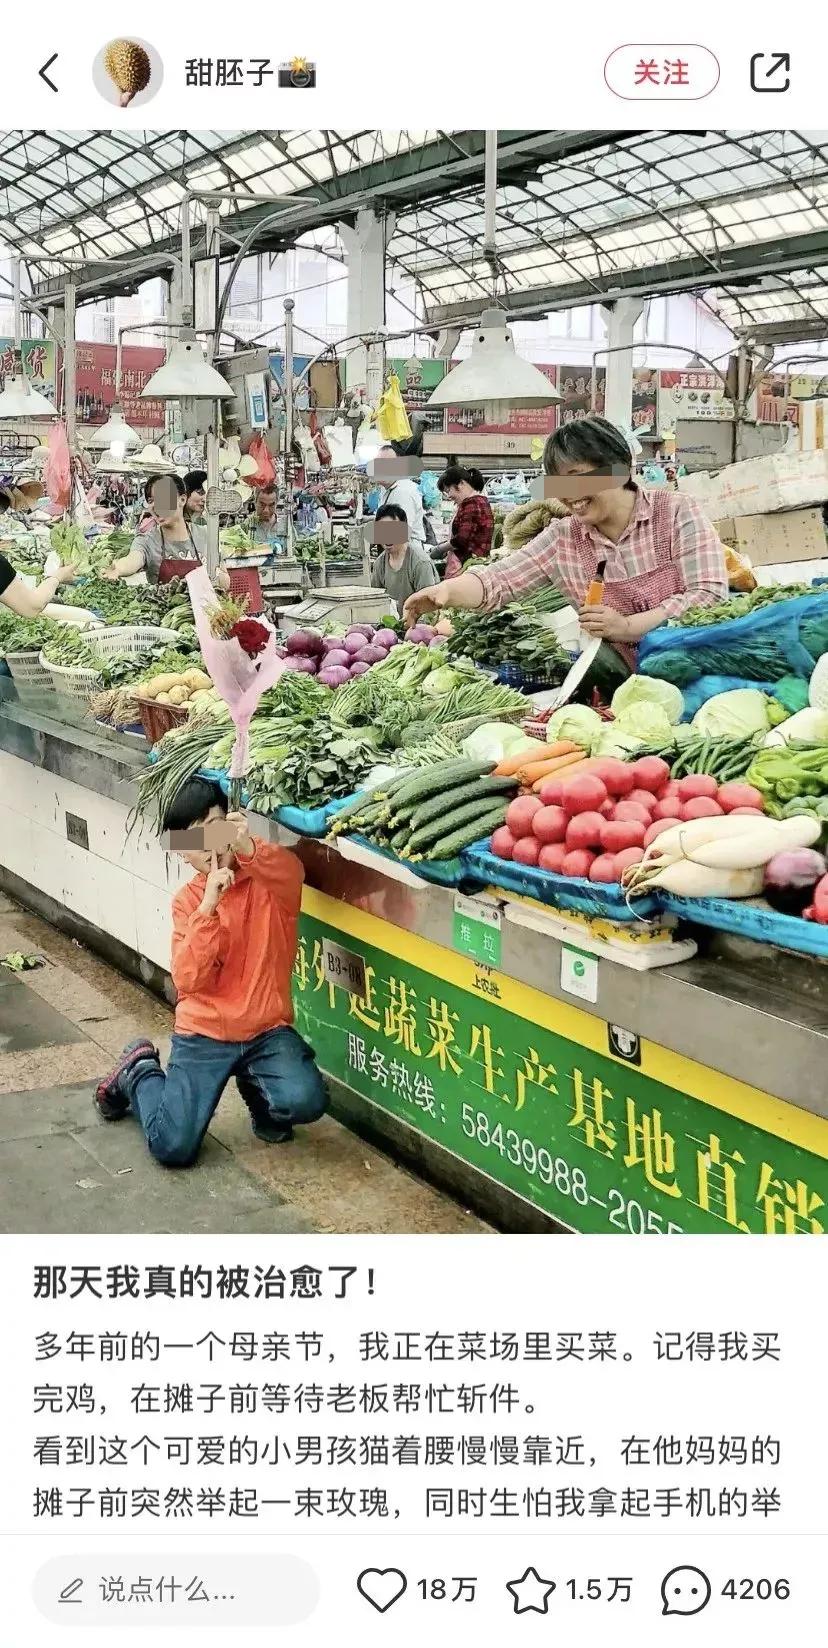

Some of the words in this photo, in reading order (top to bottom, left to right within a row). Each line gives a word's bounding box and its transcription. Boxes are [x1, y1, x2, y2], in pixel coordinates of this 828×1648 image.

[460, 923, 472, 943] 推
[483, 931, 495, 953] 拉
[327, 951, 363, 986] B3-08
